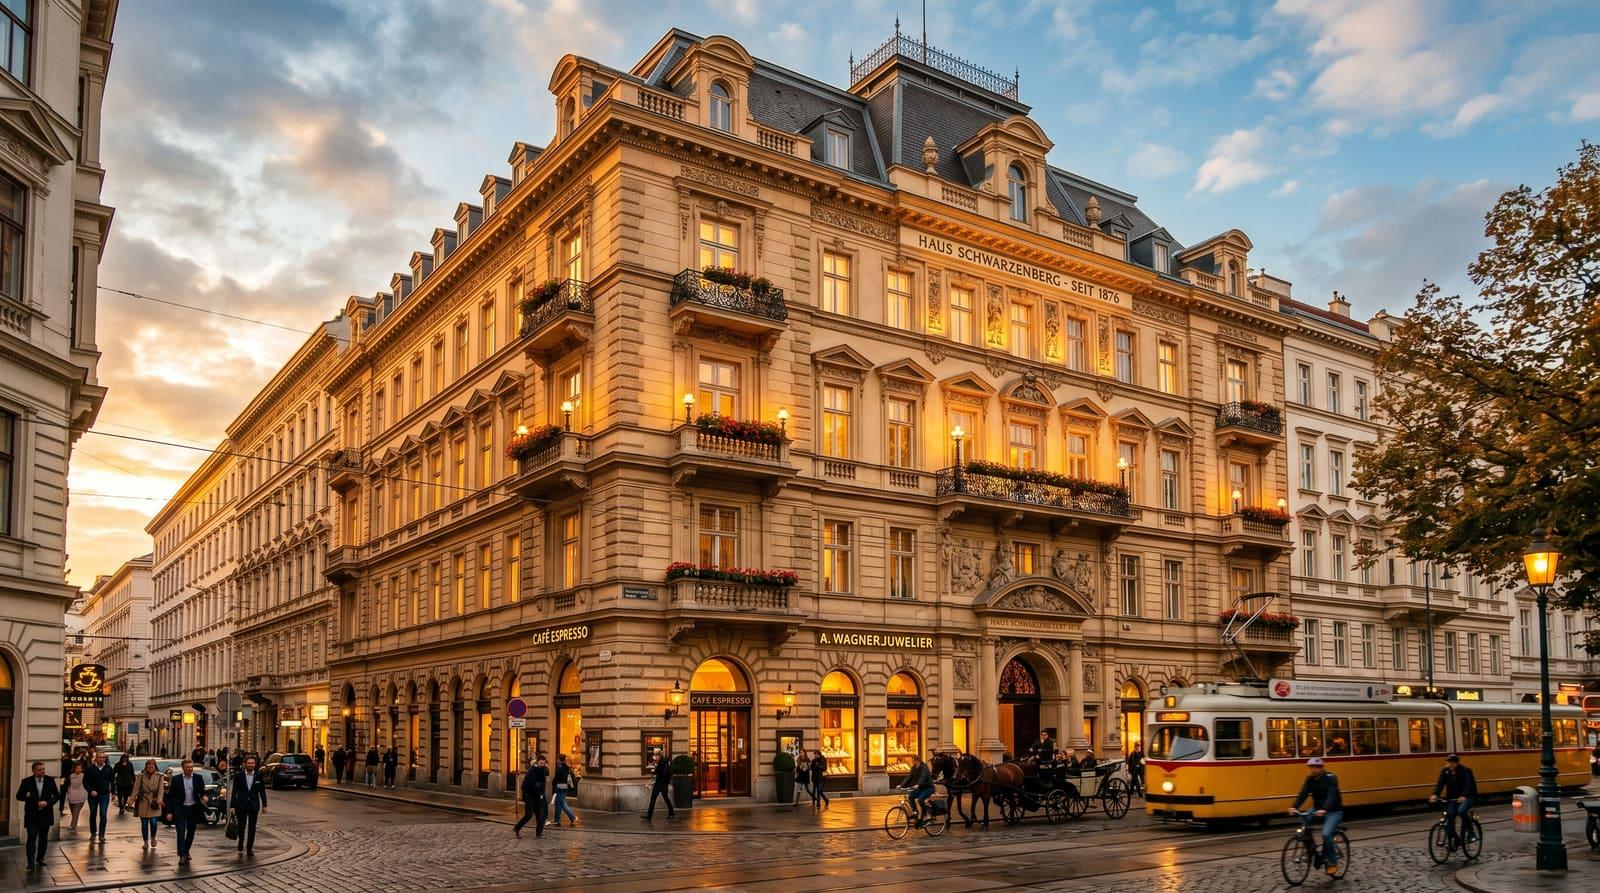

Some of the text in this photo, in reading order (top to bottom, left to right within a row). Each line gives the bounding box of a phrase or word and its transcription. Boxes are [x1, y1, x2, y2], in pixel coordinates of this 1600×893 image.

[919, 235, 953, 255] HAUS
[958, 248, 1061, 287] SCHWARZENBERG
[1071, 280, 1095, 297] SEIT
[1099, 288, 1120, 304] 1876
[532, 626, 588, 645] CAFÉ ESPRESSO
[820, 633, 831, 644] A.
[712, 696, 751, 705] ESPRESSO
